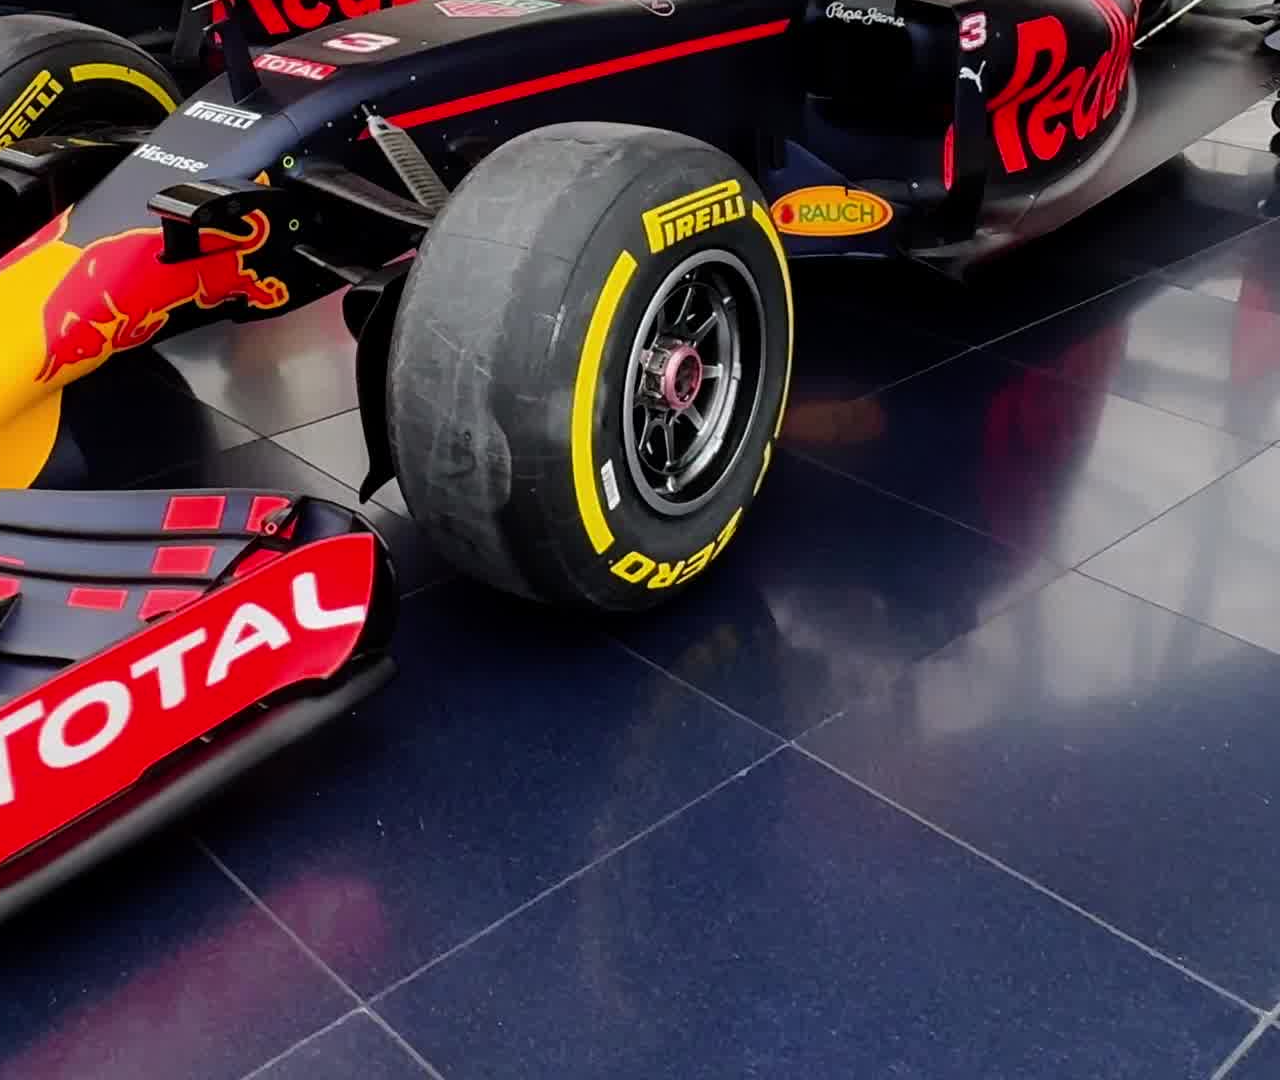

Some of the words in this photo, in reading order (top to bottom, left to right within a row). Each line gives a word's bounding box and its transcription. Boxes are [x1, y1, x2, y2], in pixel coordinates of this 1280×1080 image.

[322, 32, 400, 53] 3
[960, 10, 987, 52] 3
[257, 53, 328, 80] TOTAL
[184, 100, 262, 130] PIRELLI
[133, 143, 209, 172] Hisense
[641, 178, 746, 255] PIRELLI
[798, 203, 875, 224] RAUCH
[610, 506, 743, 589] ZERO
